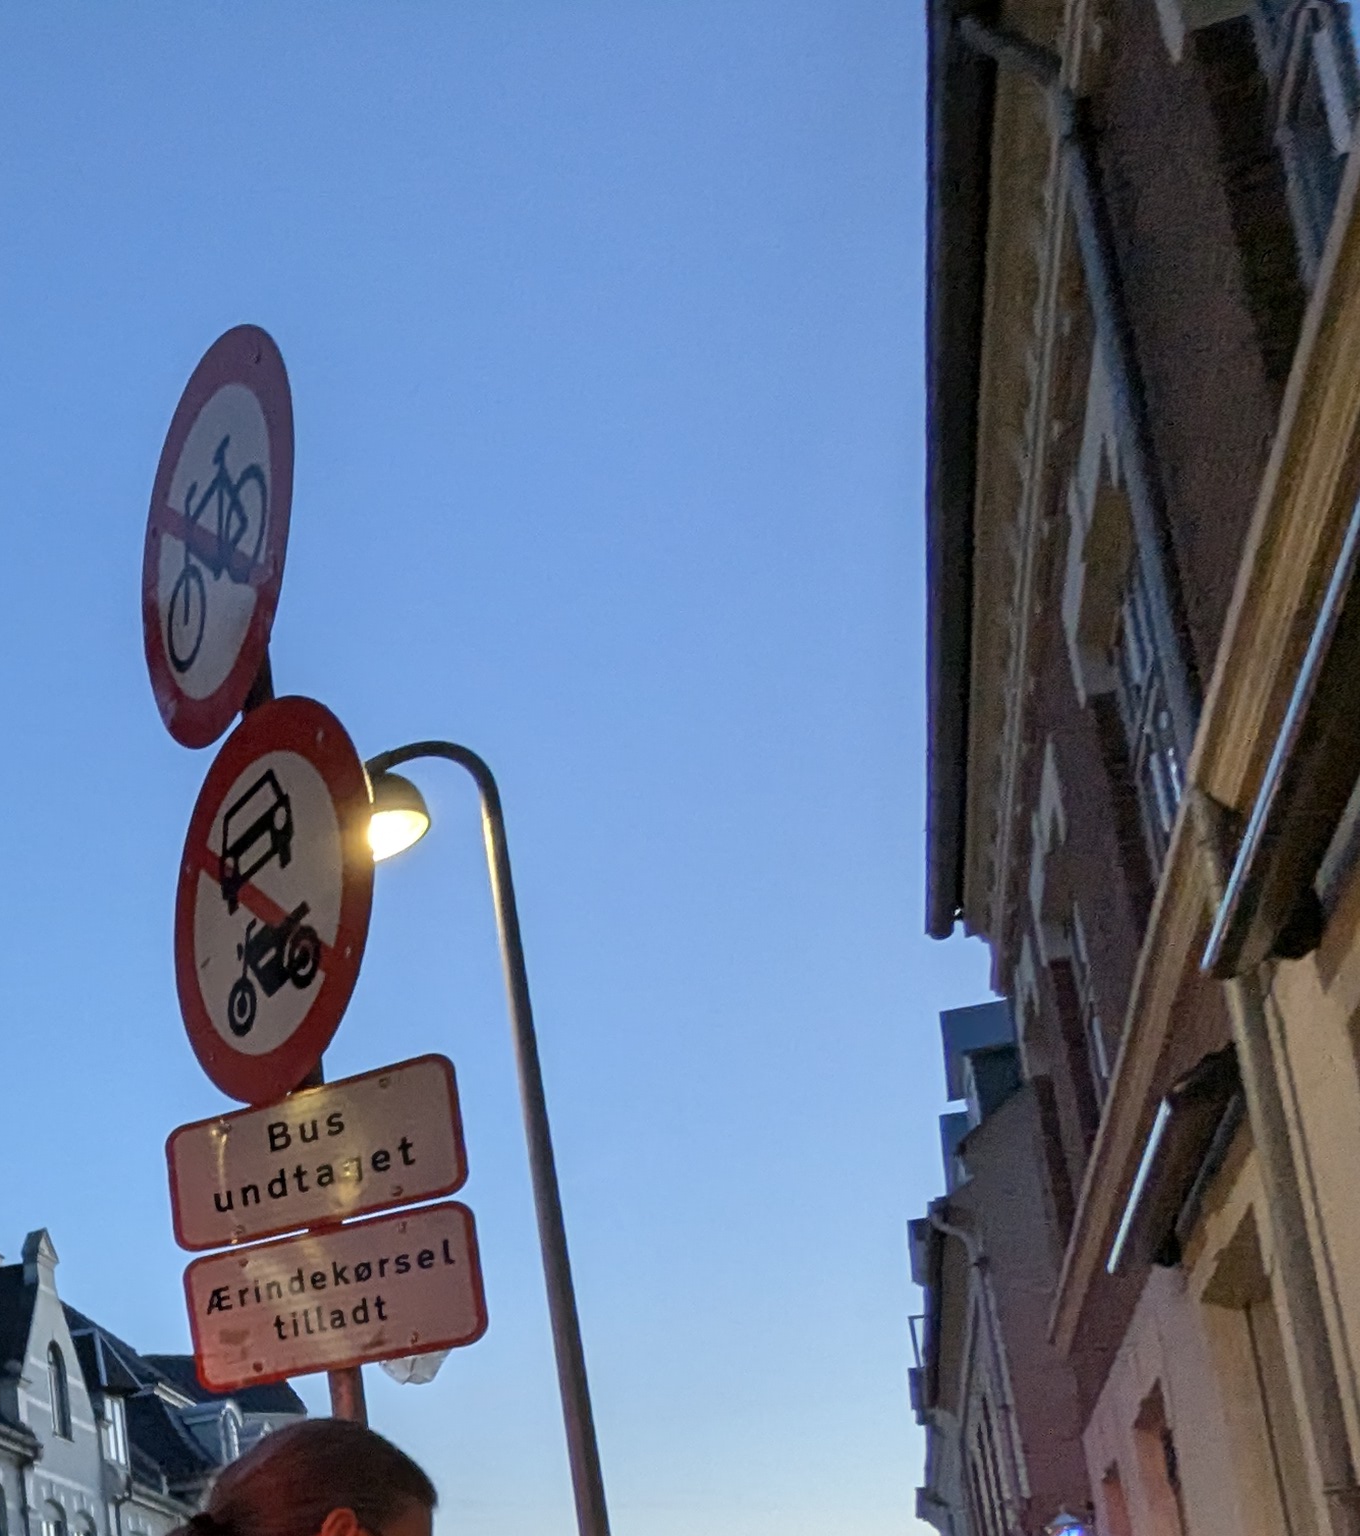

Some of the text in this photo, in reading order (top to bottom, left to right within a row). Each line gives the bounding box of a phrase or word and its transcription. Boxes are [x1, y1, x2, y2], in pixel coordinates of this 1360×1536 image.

[267, 1112, 346, 1152] Bus
[214, 1136, 416, 1212] undtaget
[207, 1239, 456, 1315] Ærindekørsel
[273, 1295, 388, 1340] tilladt
